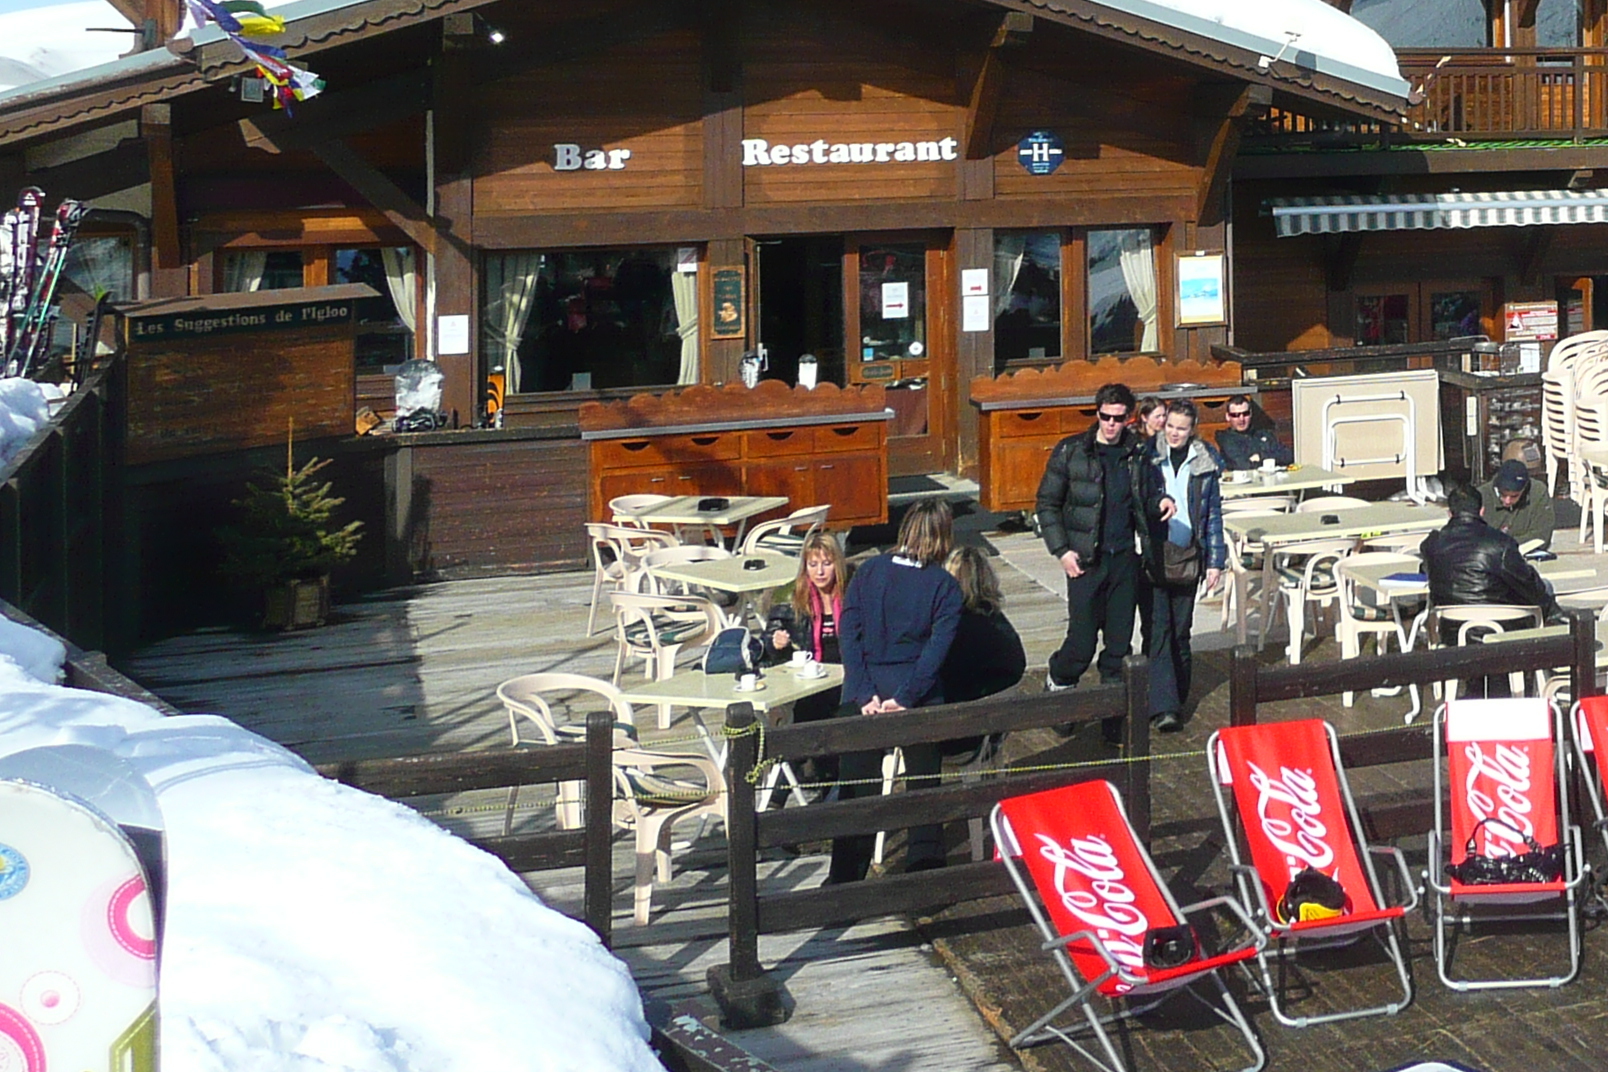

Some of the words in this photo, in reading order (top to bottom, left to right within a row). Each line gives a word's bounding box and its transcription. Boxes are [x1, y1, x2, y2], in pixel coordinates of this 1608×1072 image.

[554, 144, 631, 170] Bar
[742, 137, 957, 166] Restaurant
[1032, 143, 1049, 162] H
[136, 321, 164, 335] Les
[174, 313, 267, 333] Suggestions
[275, 310, 293, 323] de
[302, 305, 348, 321] l'Igloo
